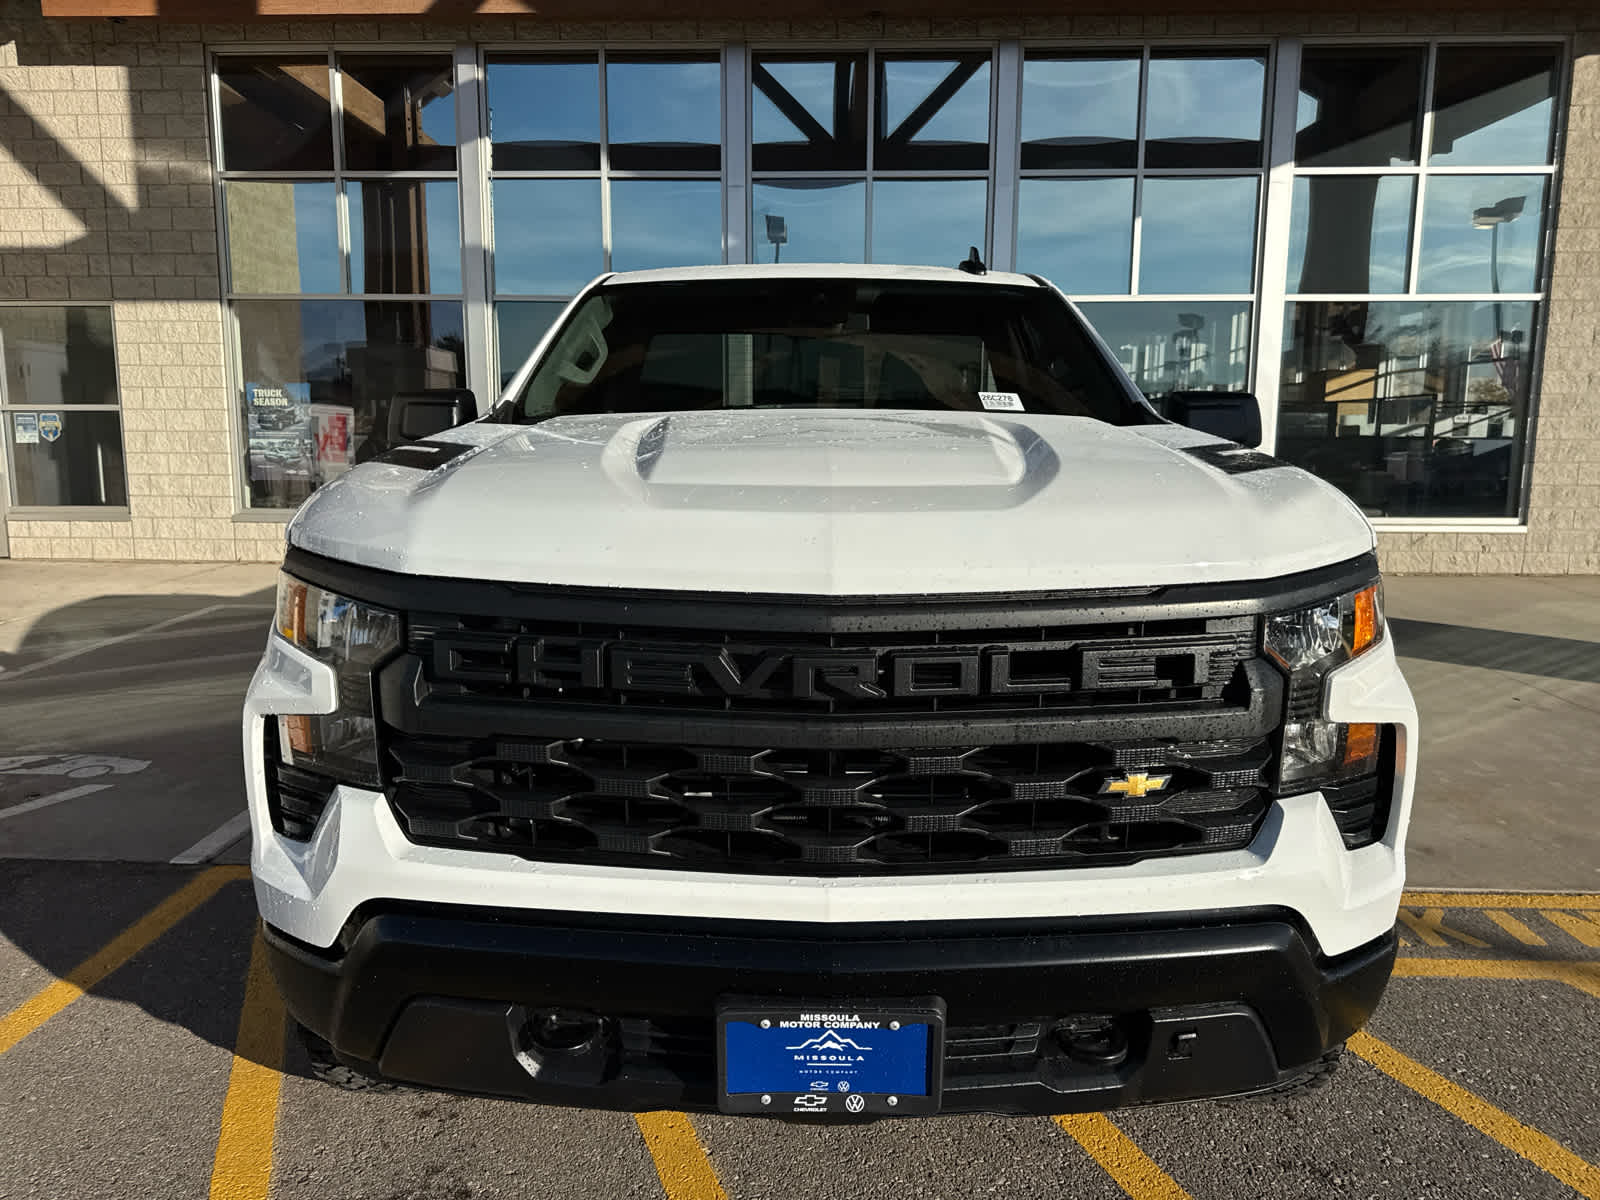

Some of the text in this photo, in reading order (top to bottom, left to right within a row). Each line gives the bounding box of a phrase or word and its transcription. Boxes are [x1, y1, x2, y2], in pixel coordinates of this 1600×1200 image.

[252, 389, 283, 398] TRUCK
[253, 398, 289, 406] SEASON
[432, 636, 1237, 697] CHEVROLET
[824, 1021, 880, 1029] COMPANY
